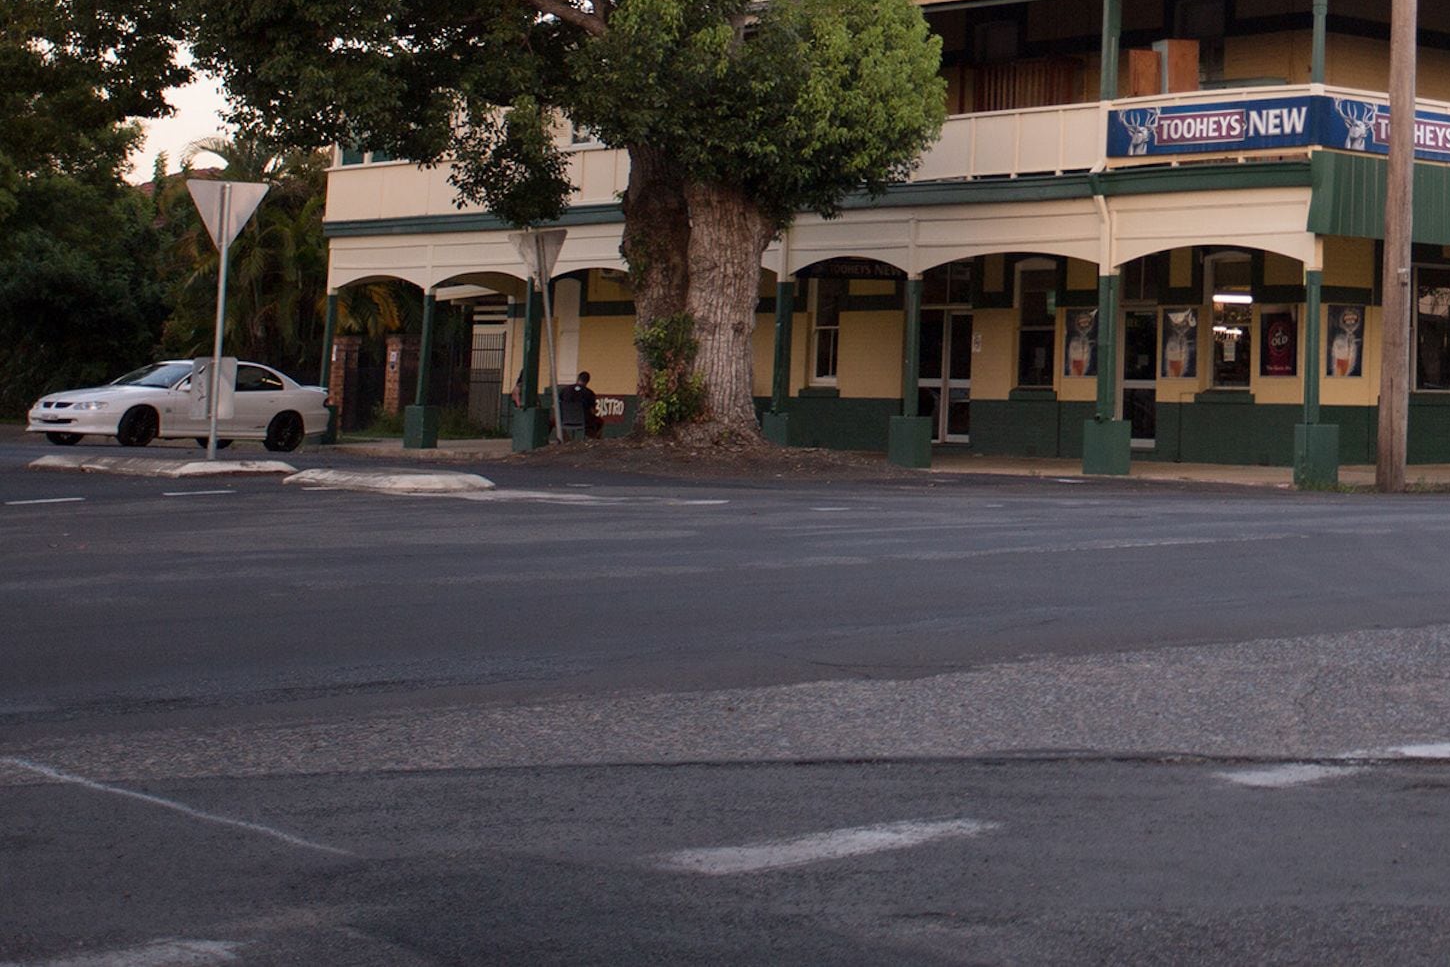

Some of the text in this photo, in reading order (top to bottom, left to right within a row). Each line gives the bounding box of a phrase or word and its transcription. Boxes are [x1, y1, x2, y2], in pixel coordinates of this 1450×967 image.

[1160, 107, 1307, 139] TOOHEYS NEW
[1272, 336, 1288, 346] OLD
